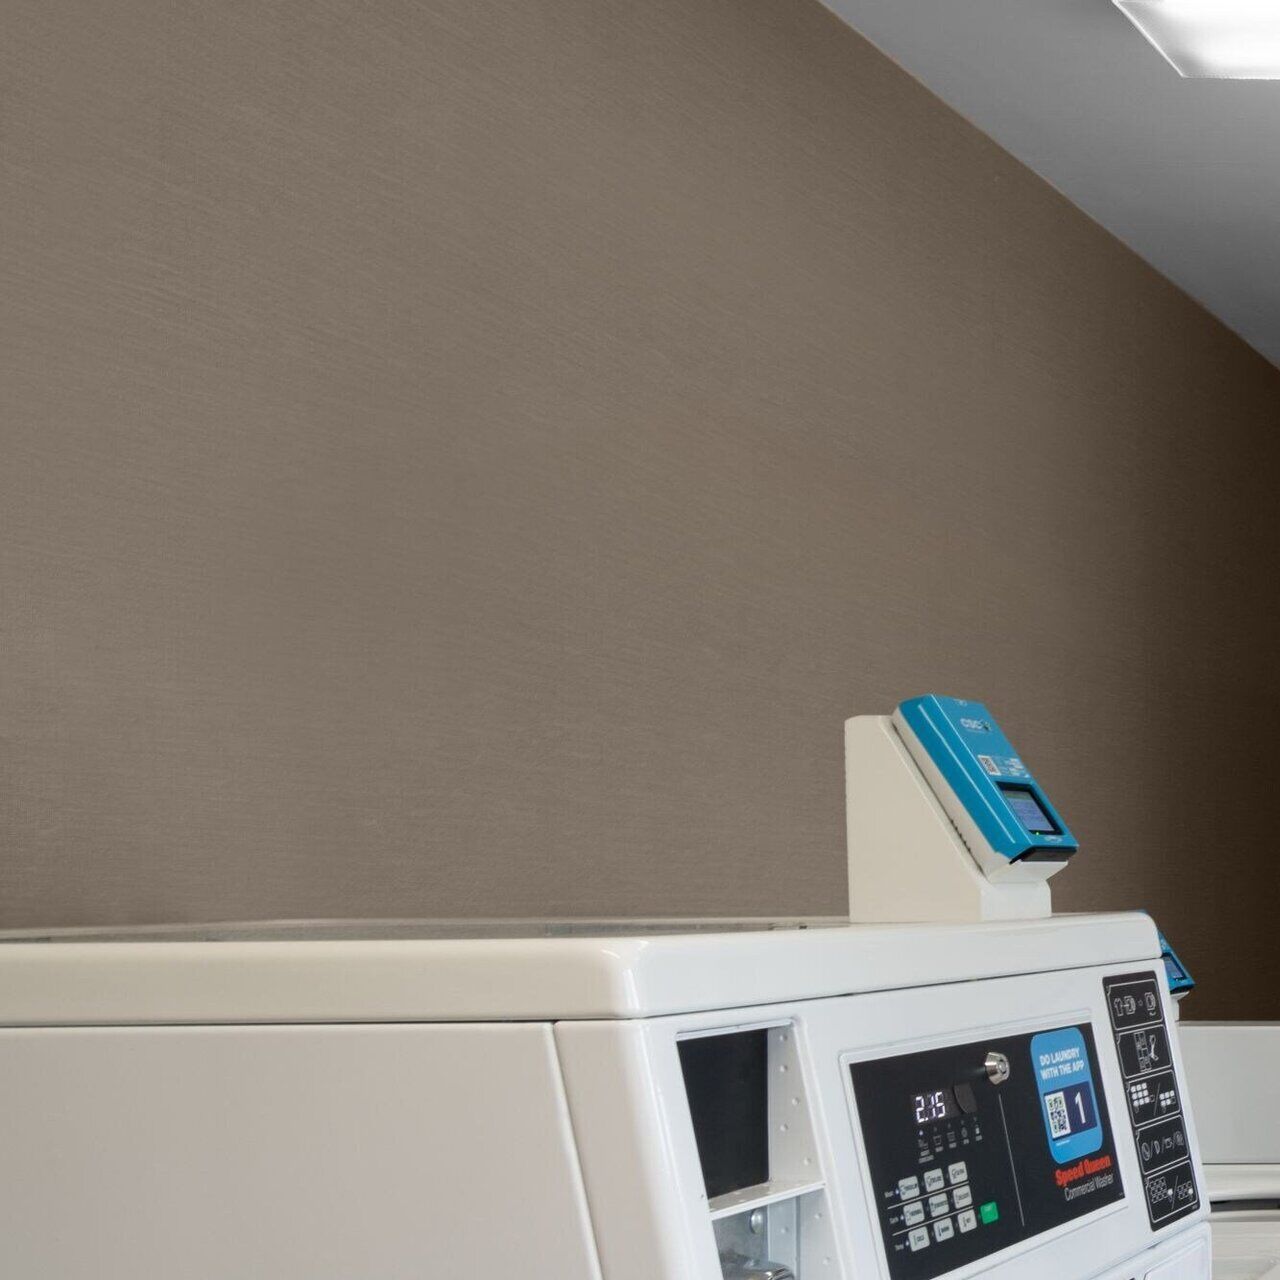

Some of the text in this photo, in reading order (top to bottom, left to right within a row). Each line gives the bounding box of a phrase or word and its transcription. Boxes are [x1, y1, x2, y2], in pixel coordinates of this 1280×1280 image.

[1039, 1047, 1080, 1066] DO LAUNDRY
[1041, 1060, 1085, 1080] WITH THE APP
[915, 1092, 946, 1123] 2.15
[1075, 1091, 1086, 1124] 1
[1055, 1155, 1112, 1188] Speed Queen
[1064, 1173, 1115, 1201] Commercial Washer
